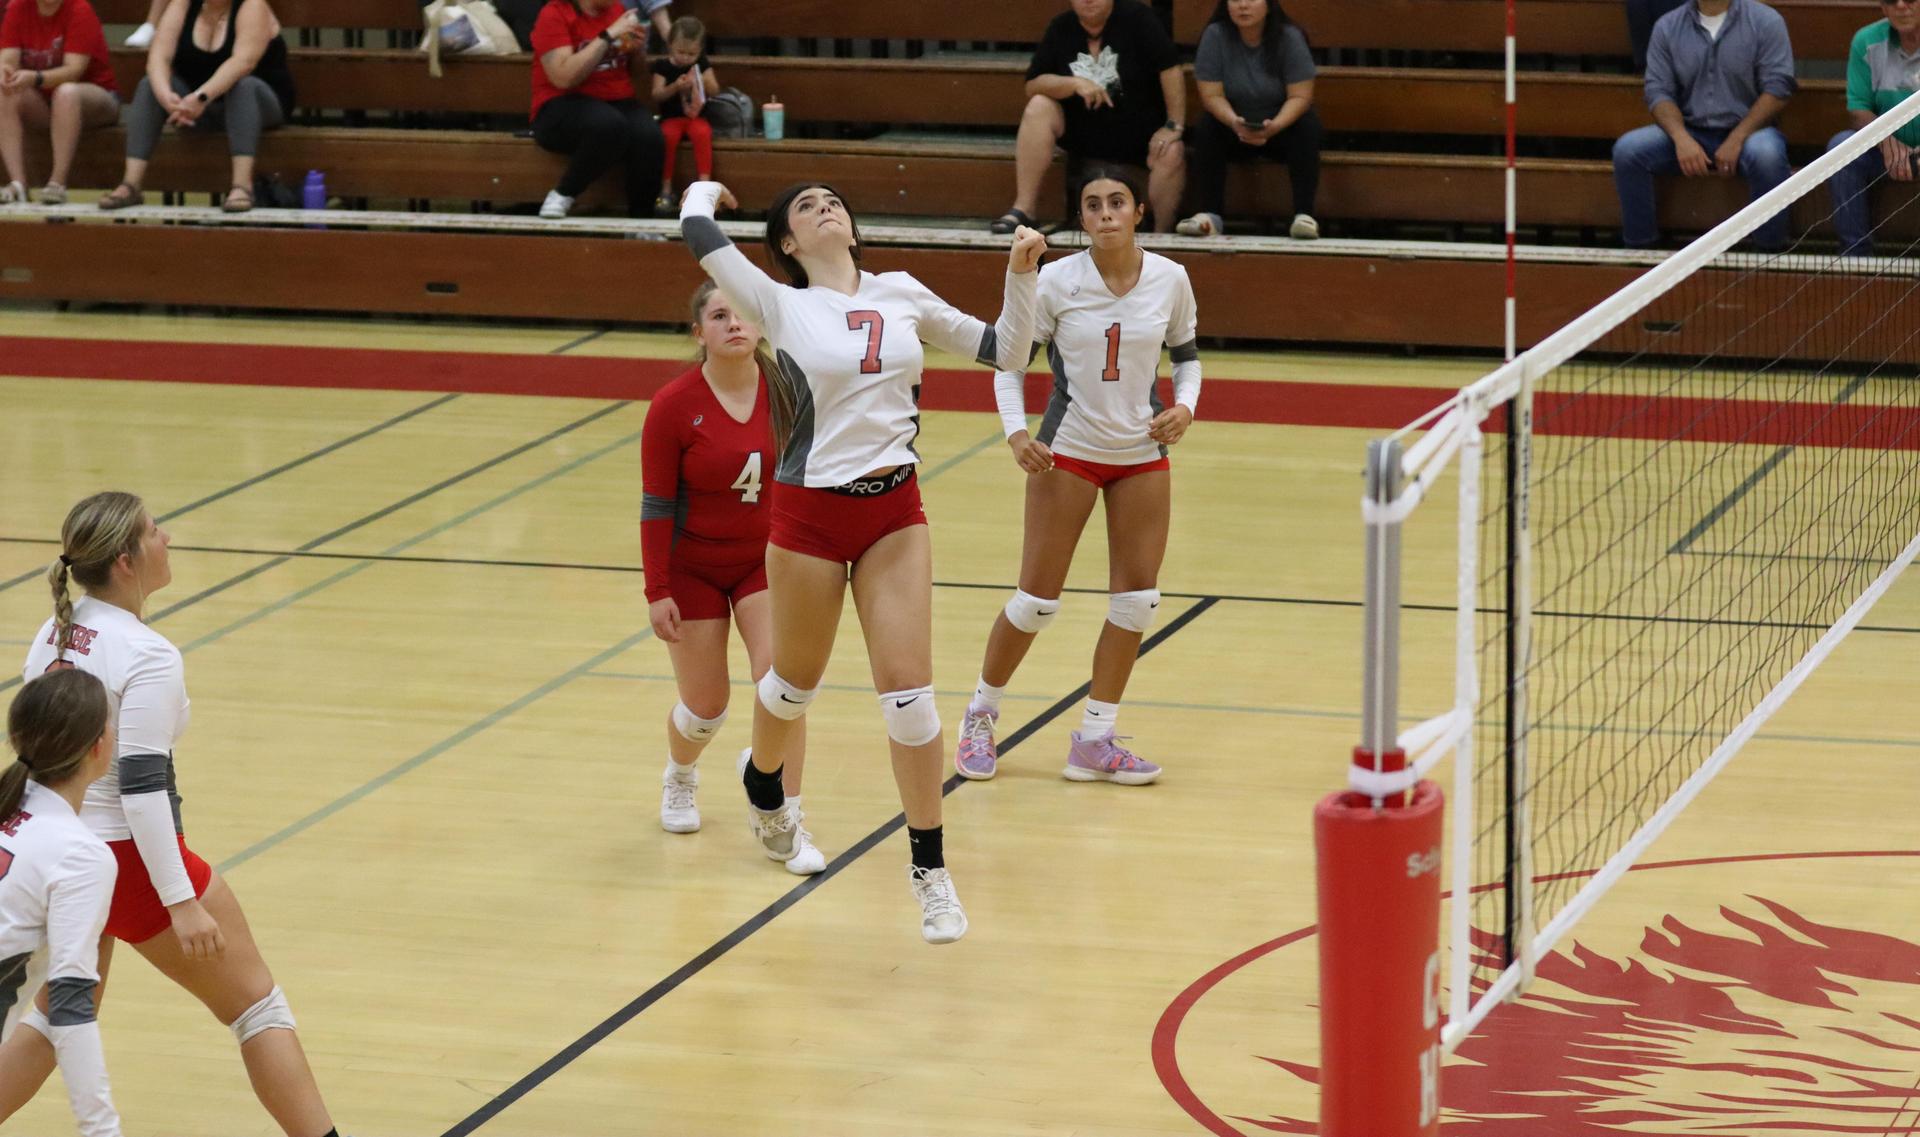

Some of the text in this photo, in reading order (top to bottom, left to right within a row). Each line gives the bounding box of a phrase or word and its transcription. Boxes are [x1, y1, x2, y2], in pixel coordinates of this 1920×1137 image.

[845, 310, 884, 375] 7
[1102, 322, 1121, 382] 1
[729, 450, 763, 504] 4
